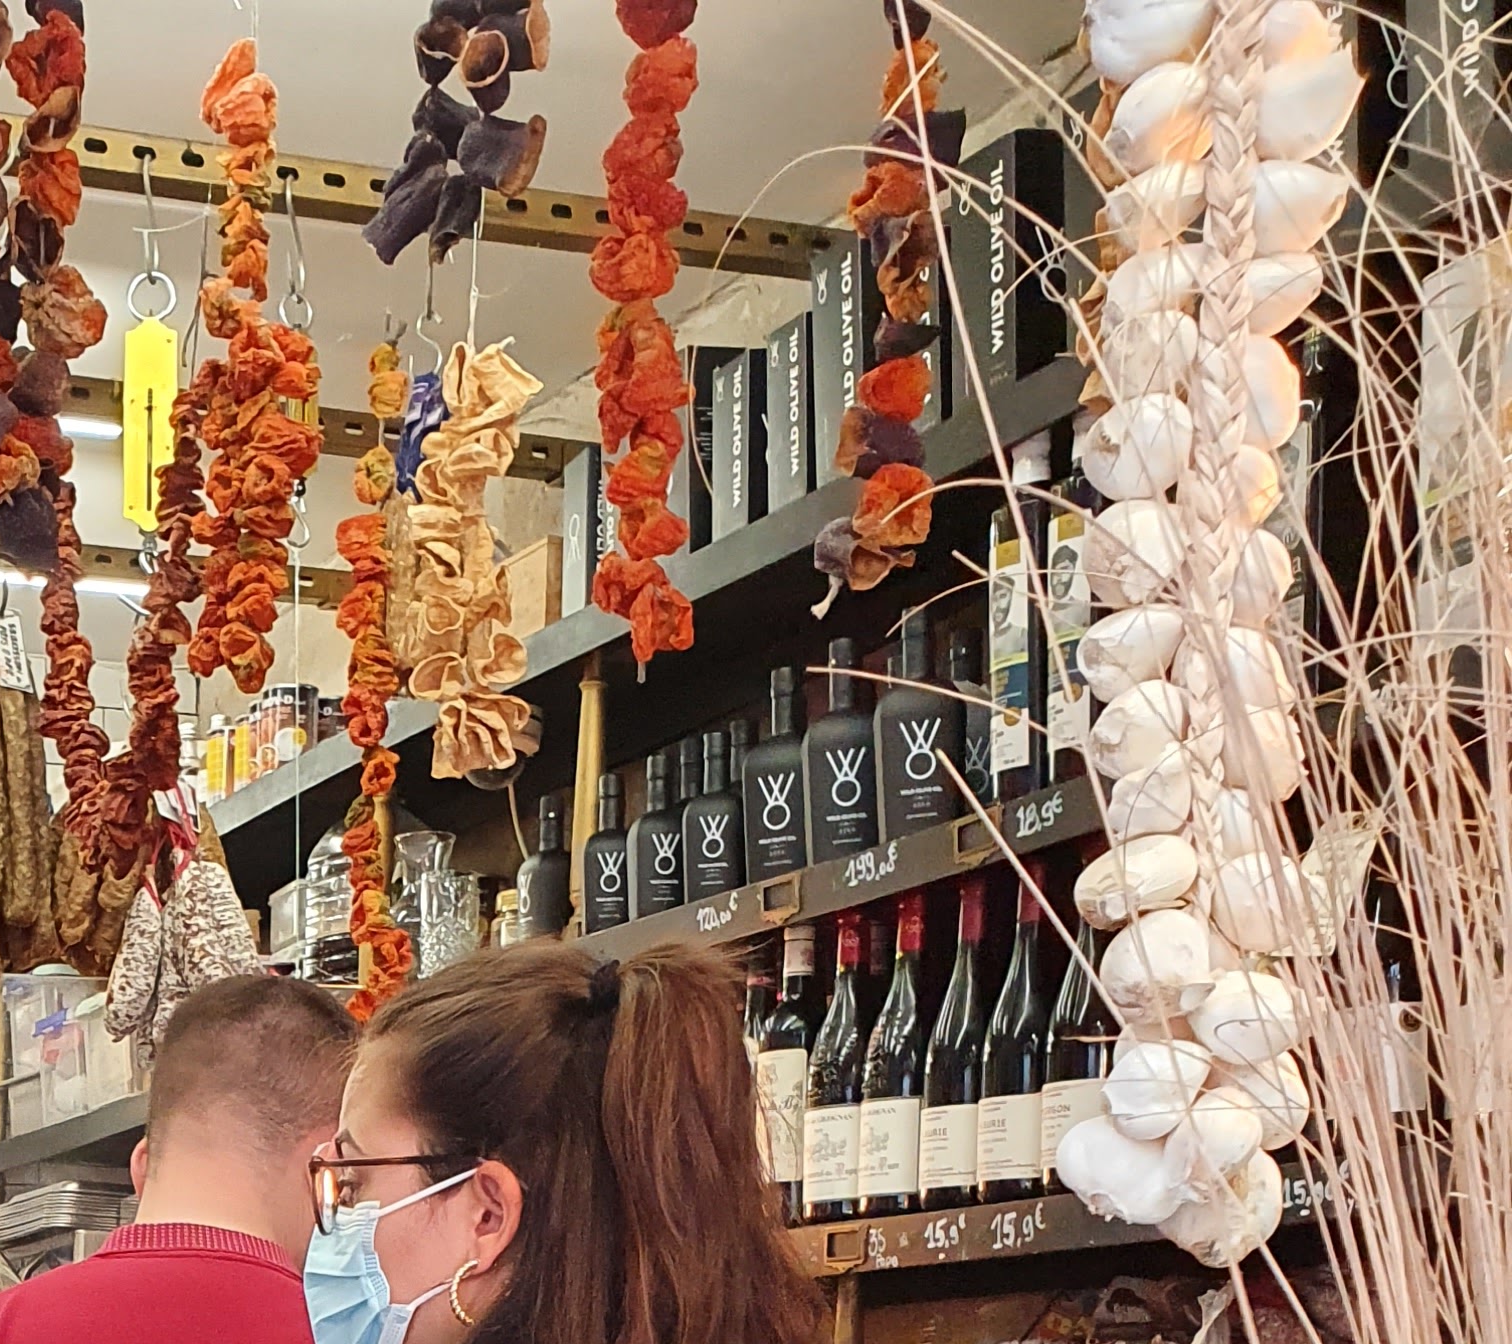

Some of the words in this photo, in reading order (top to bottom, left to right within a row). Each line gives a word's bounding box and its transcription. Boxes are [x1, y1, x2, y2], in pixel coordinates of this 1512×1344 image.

[990, 159, 1004, 205] OIL
[990, 206, 1005, 284] OLIVE
[840, 252, 852, 290] OIL
[789, 327, 799, 360] OIL
[841, 299, 854, 367] OLIVE
[991, 291, 1006, 355] WILD
[732, 364, 743, 398] OIL
[789, 364, 800, 424] OLIVE
[844, 371, 855, 415] ILD
[732, 400, 743, 458] OLIVE
[791, 428, 800, 477] WILD
[732, 460, 743, 508] WILD
[990, 1201, 1047, 1250] 15,9€
